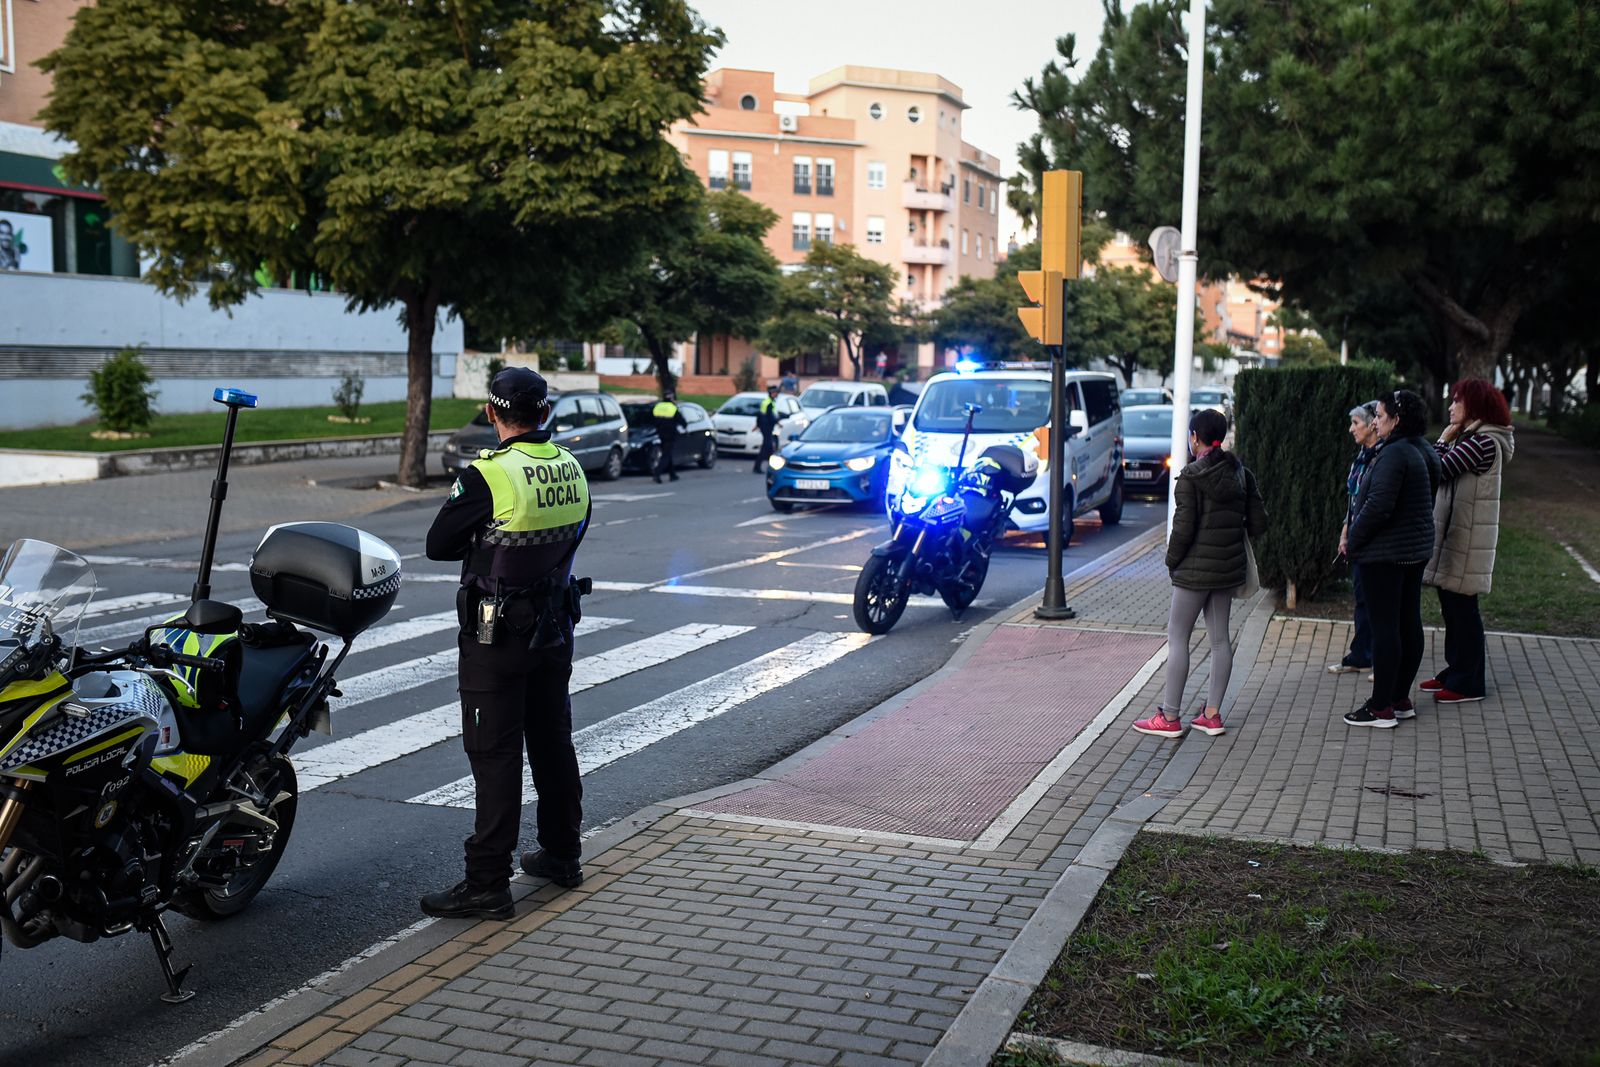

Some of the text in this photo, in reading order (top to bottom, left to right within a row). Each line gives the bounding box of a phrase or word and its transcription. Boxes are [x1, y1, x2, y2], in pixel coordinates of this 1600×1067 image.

[522, 461, 581, 485] POLICIA
[536, 483, 581, 508] LOCAL
[370, 564, 387, 578] M-38
[65, 746, 128, 777] POLICIA LOCAL
[109, 775, 130, 793] 092
